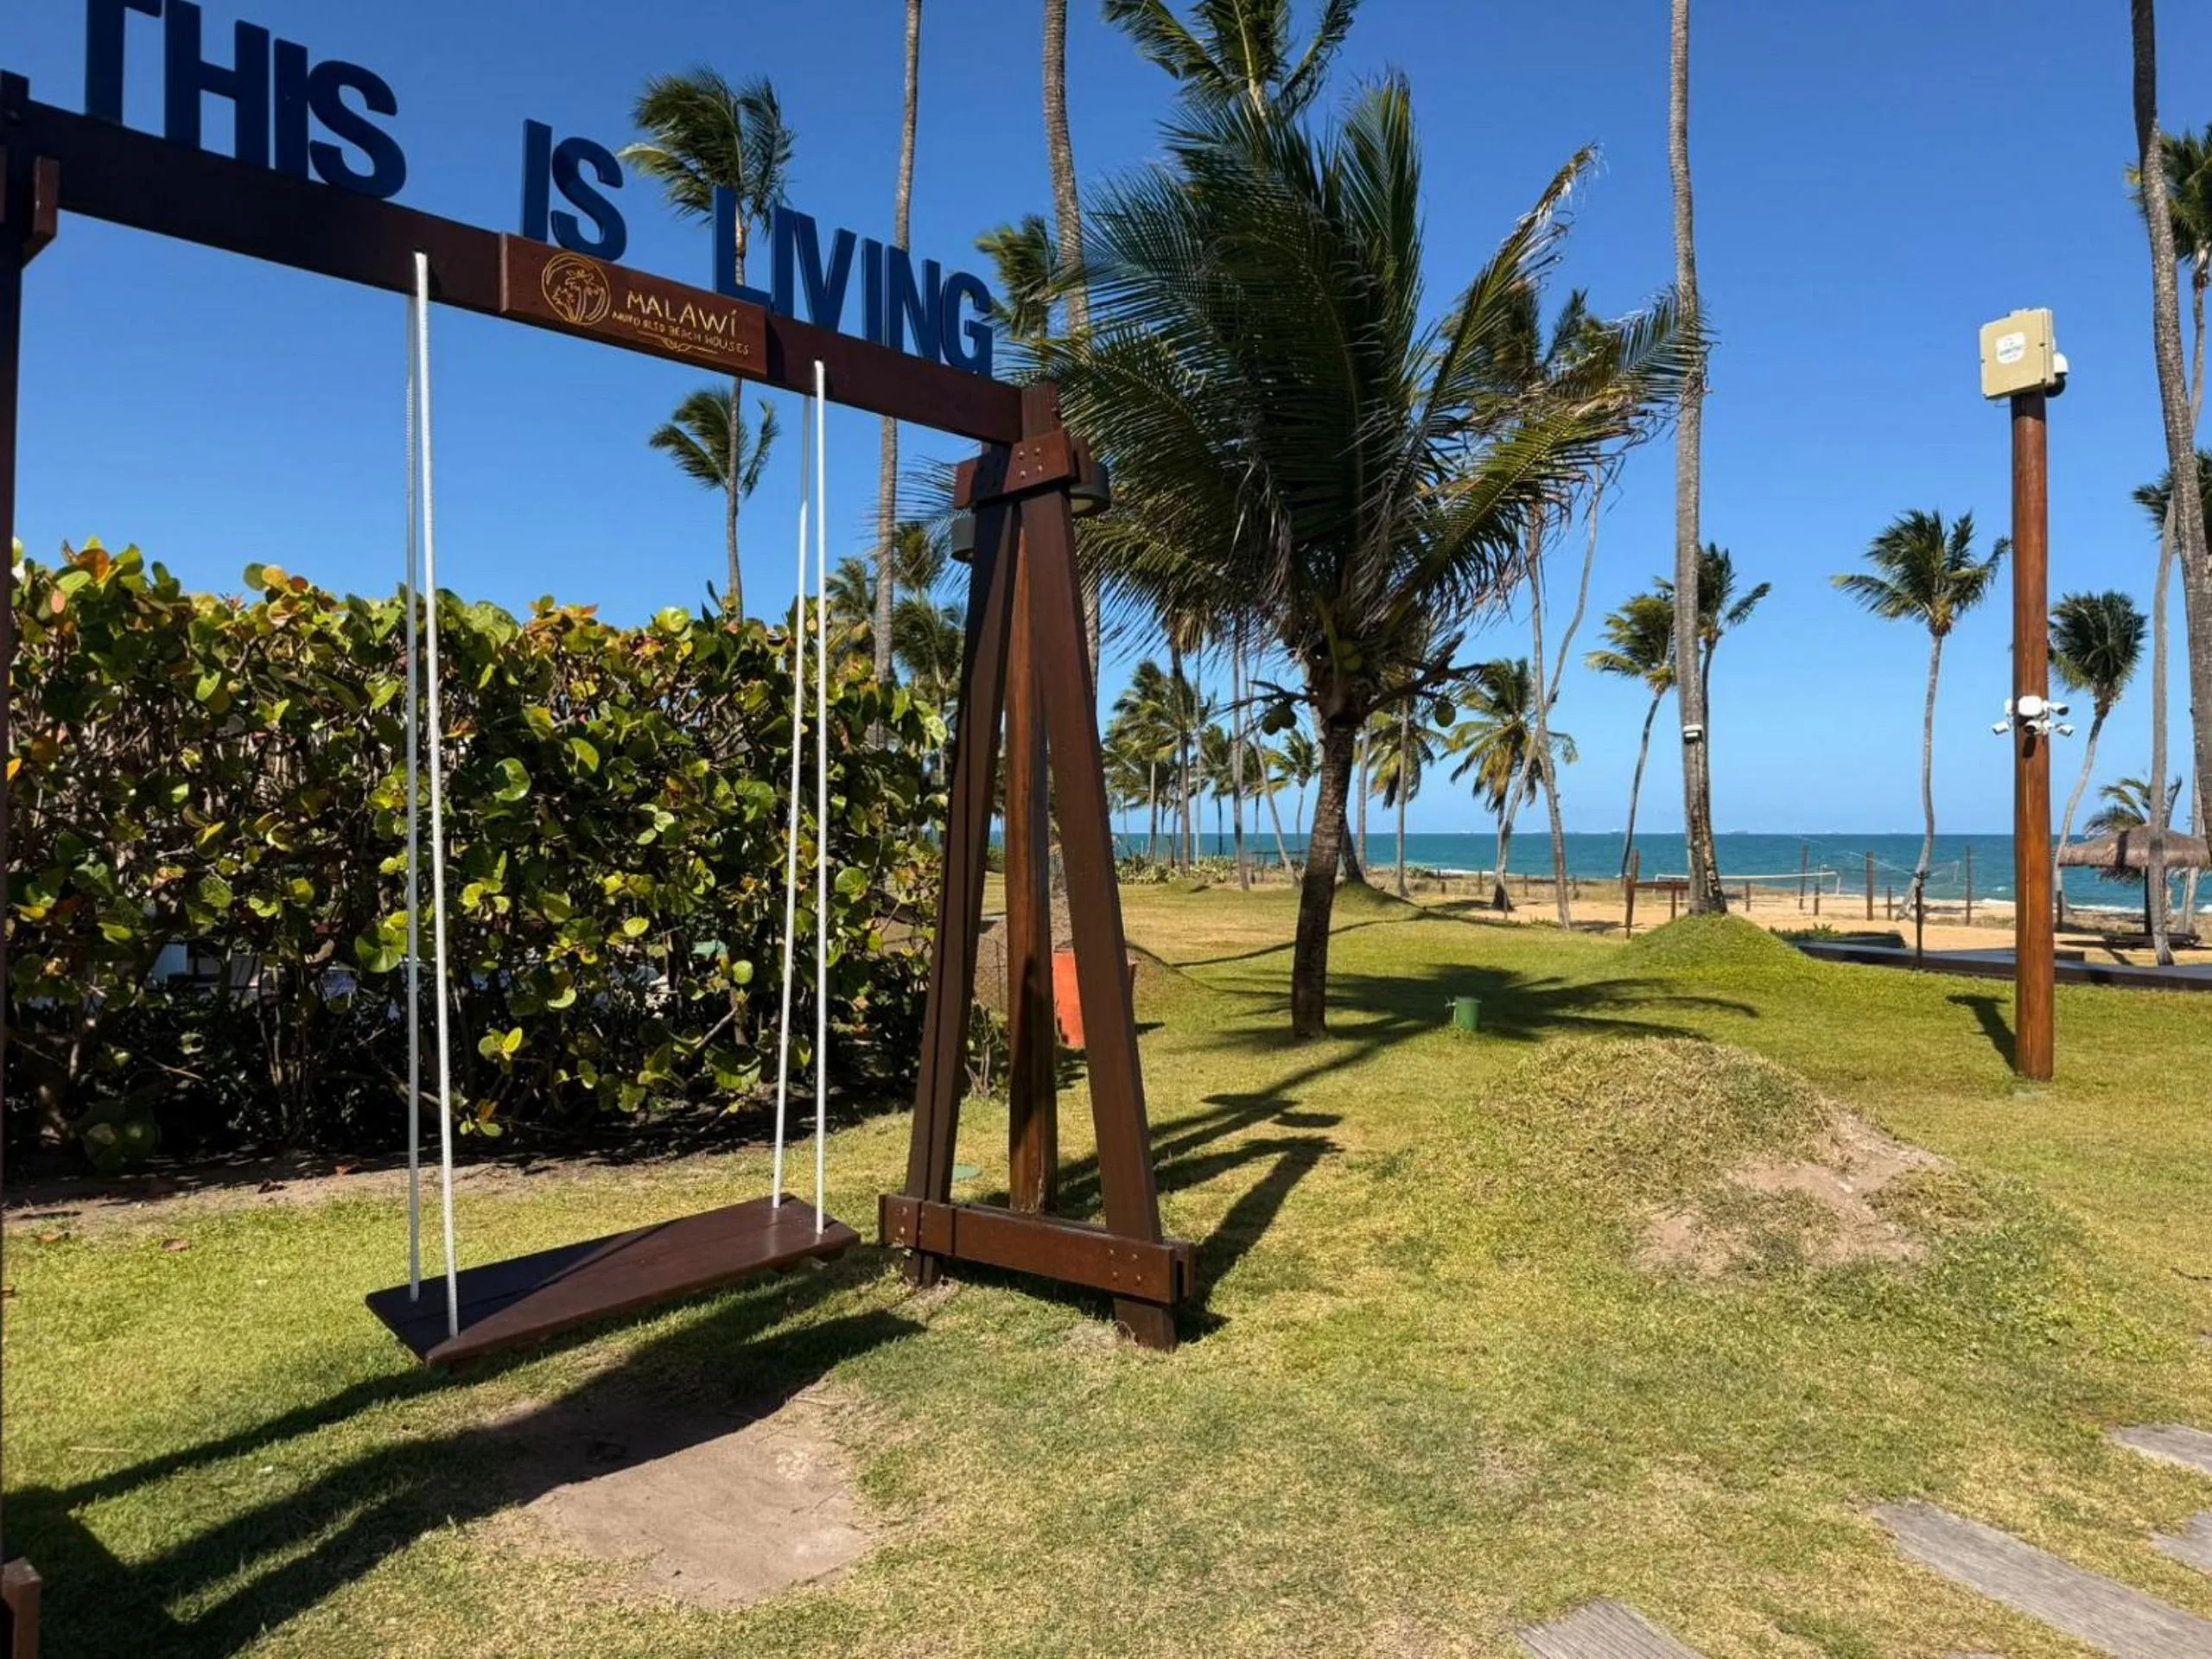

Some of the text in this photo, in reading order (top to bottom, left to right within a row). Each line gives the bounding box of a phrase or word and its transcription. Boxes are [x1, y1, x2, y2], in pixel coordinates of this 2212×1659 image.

[85, 0, 993, 377] THIS IS LIVING
[704, 334, 749, 355] HOUSES
